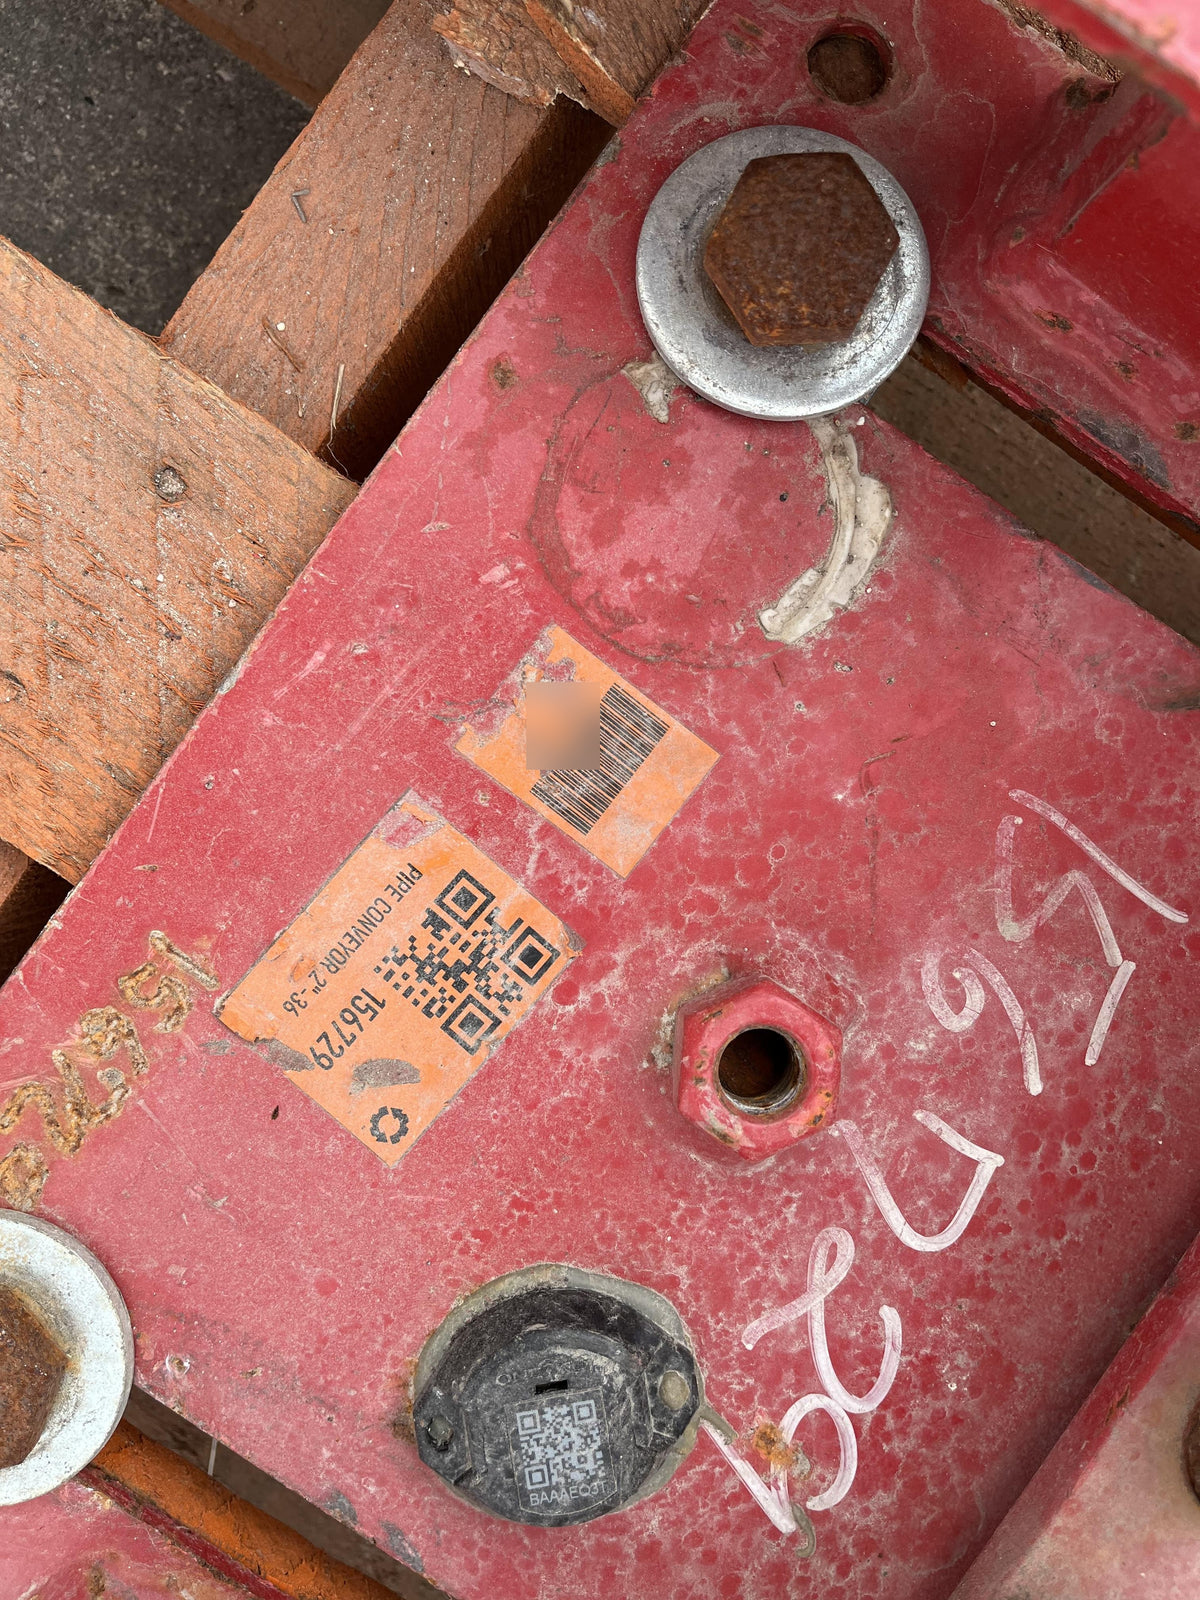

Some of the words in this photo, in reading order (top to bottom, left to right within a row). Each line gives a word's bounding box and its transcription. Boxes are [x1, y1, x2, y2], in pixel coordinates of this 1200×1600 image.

[382, 862, 424, 903] PIPE
[318, 896, 393, 976] CONVEYOR
[281, 969, 328, 1018] 2"-36
[308, 987, 387, 1071] 156729
[702, 789, 1189, 1534] 156729
